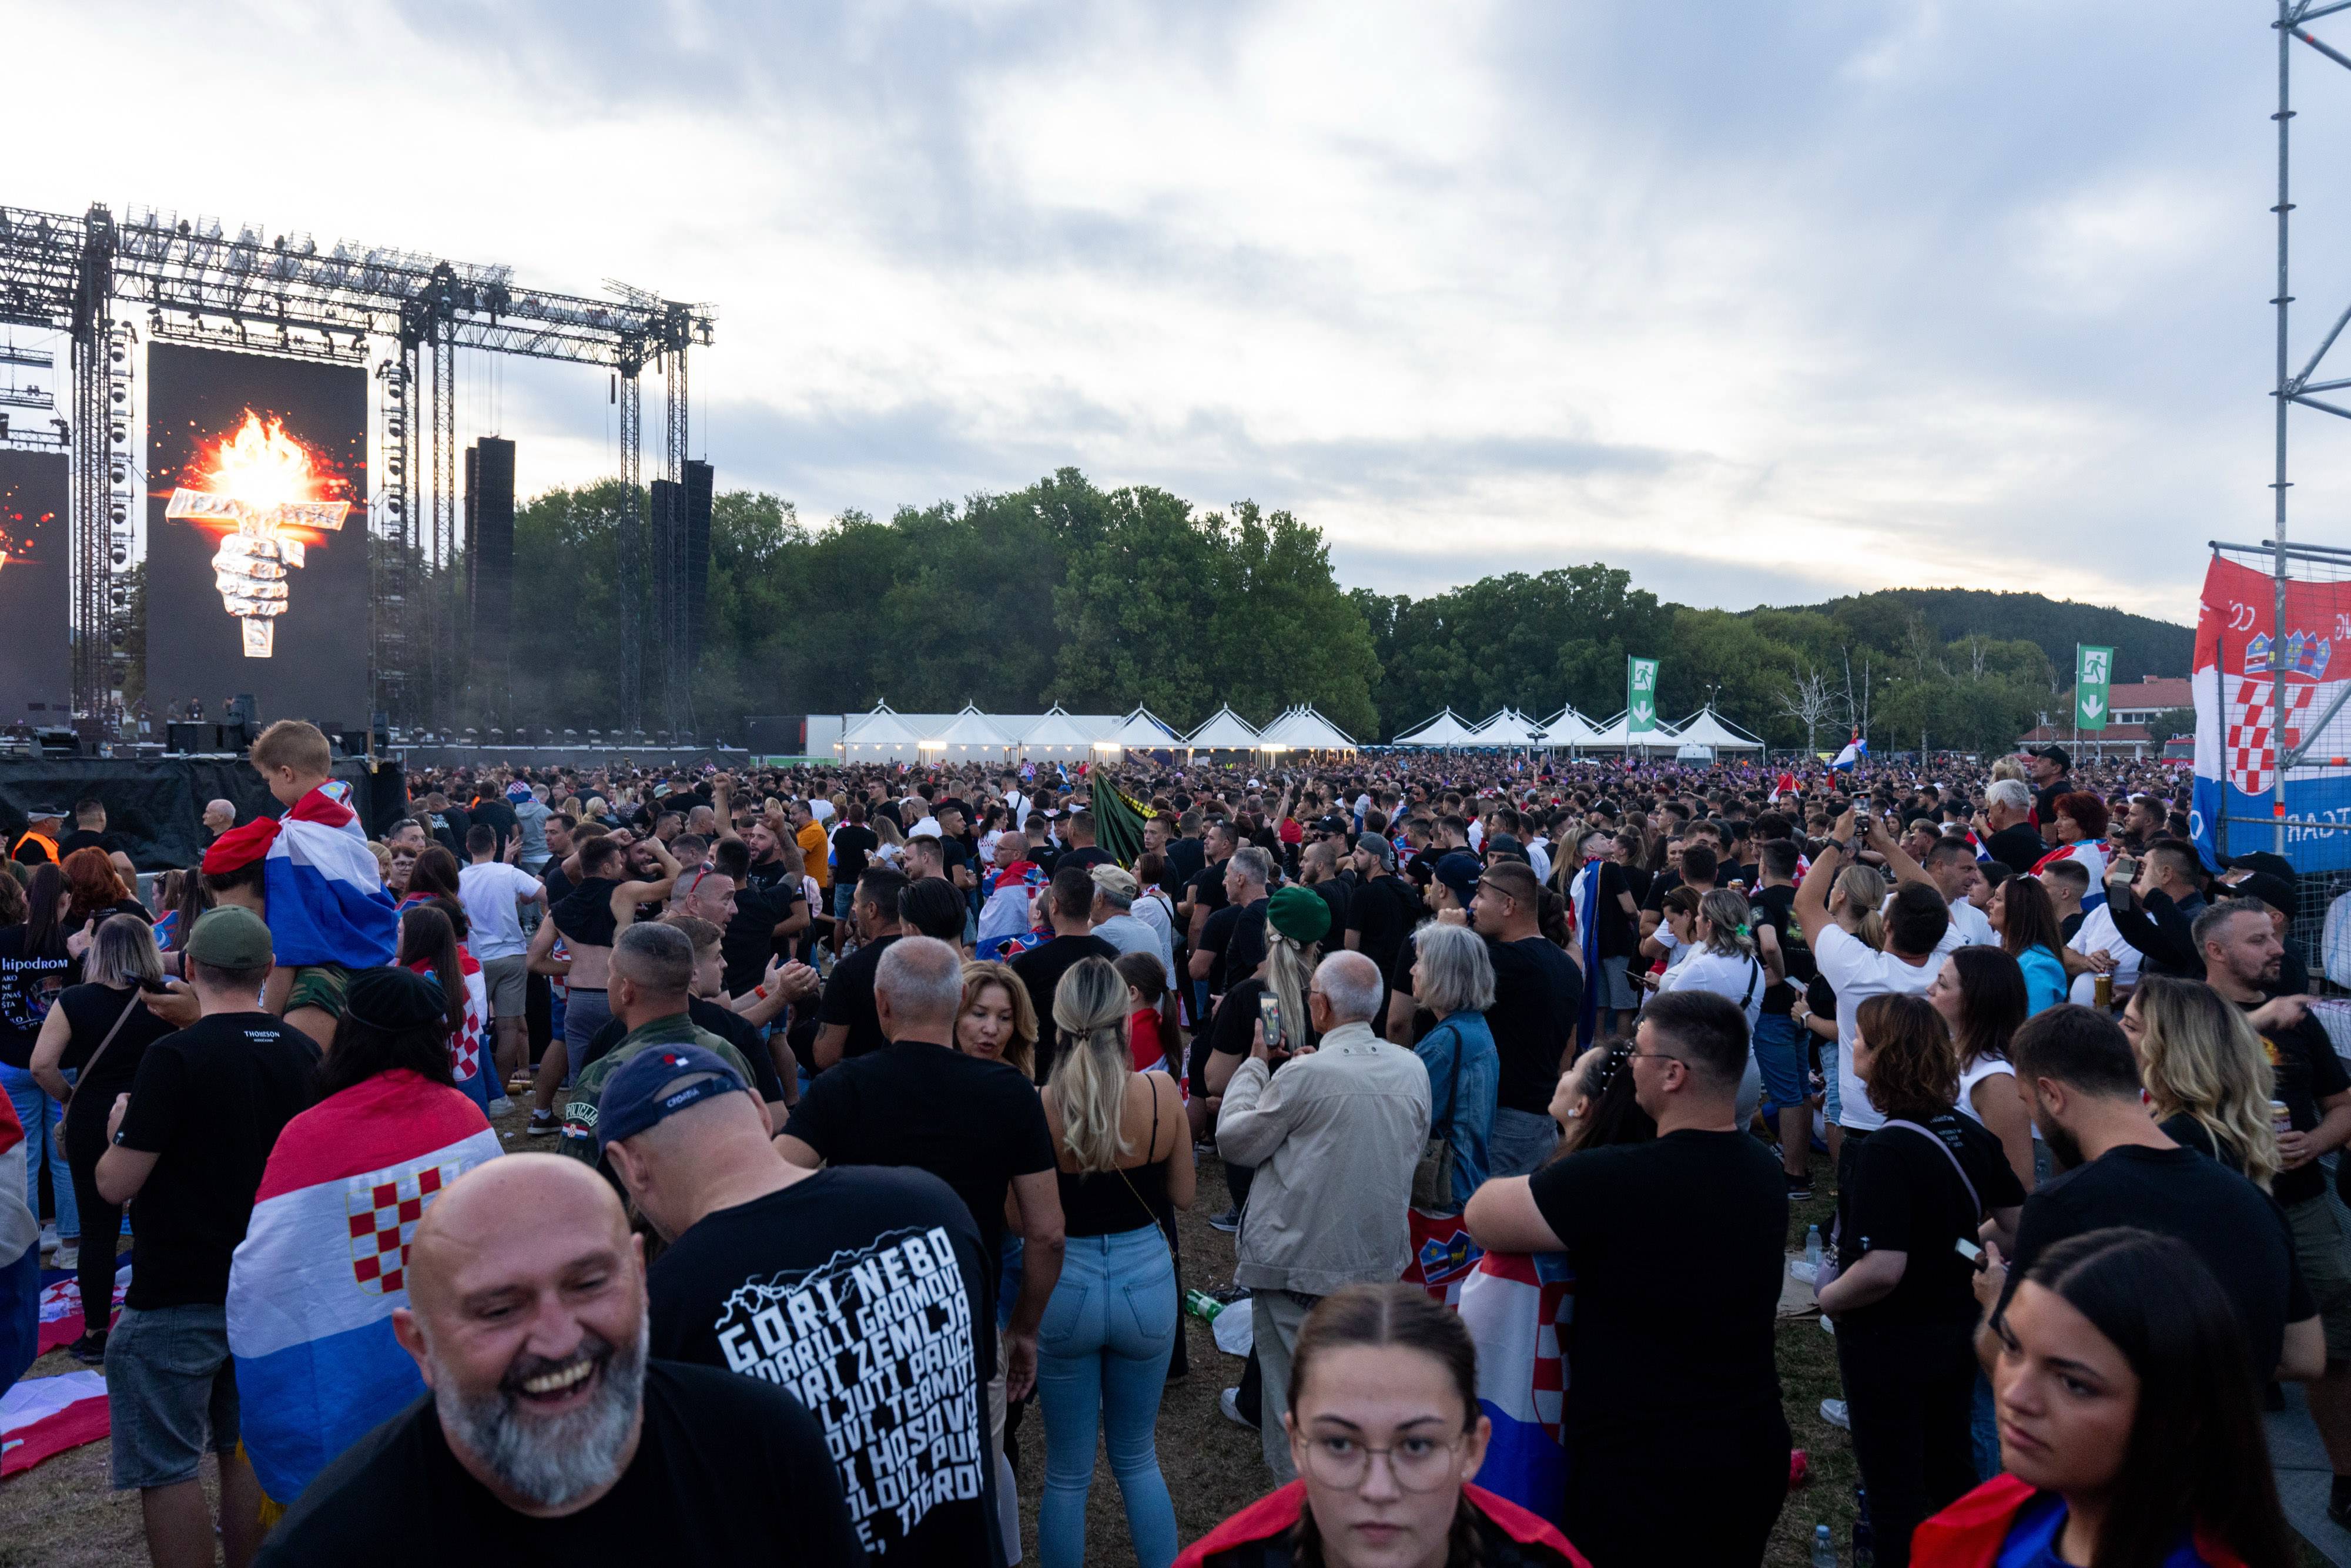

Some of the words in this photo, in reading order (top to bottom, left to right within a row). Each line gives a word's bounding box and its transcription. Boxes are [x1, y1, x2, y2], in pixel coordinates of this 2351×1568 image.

[2, 990, 22, 1000] ZNAŠ
[2, 1000, 16, 1009] ŠTA
[567, 1104, 598, 1124] POLICIJA
[718, 1278, 842, 1374] GORI
[851, 1226, 957, 1305] NEBO
[744, 1317, 855, 1385] DARILI
[855, 1262, 964, 1339] GROMOVI
[850, 1287, 972, 1381] ZEMLJA
[820, 1362, 902, 1433] LJUTI
[909, 1324, 974, 1385] PAUCI
[825, 1411, 886, 1462] OVI,
[885, 1352, 976, 1425] TERMITI
